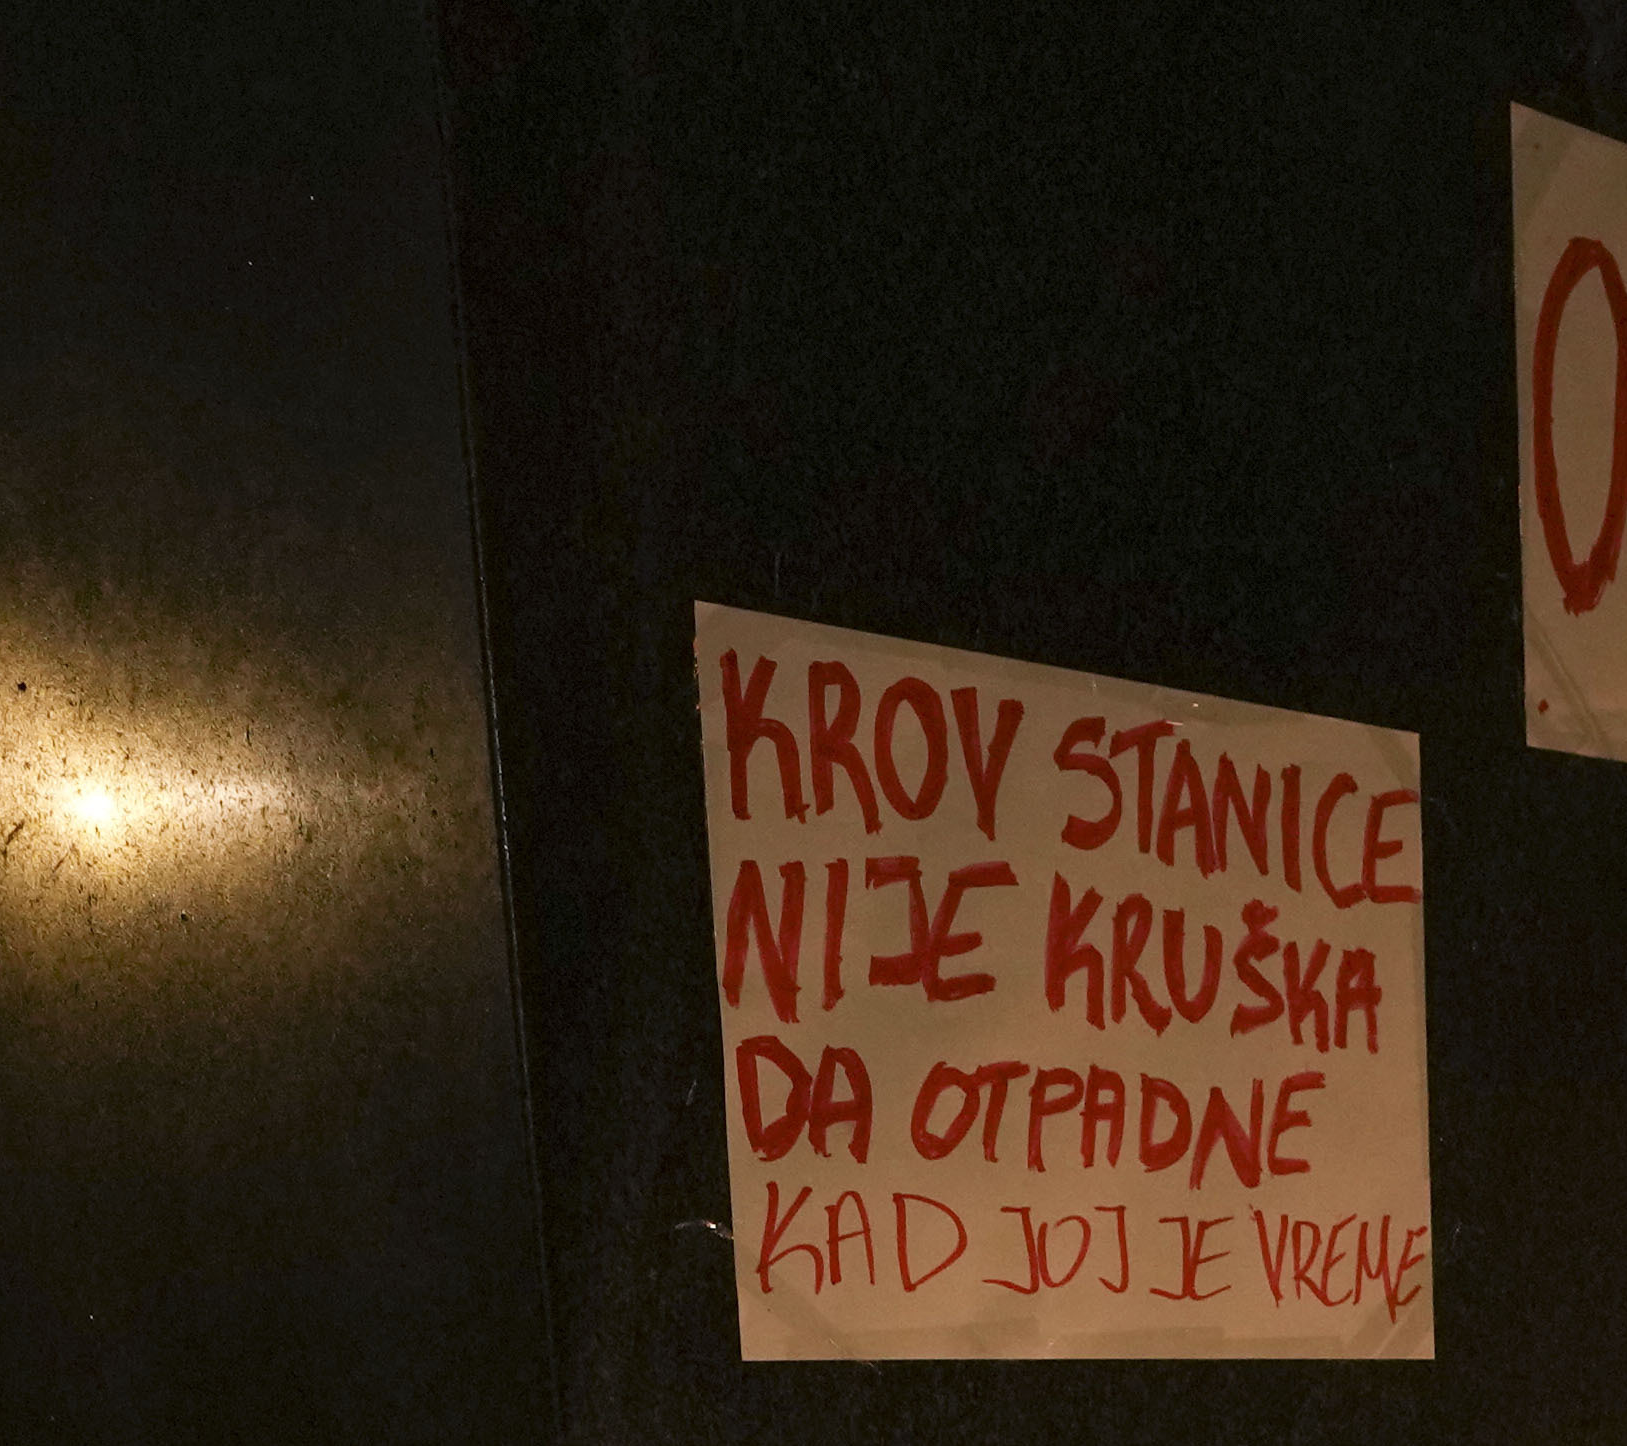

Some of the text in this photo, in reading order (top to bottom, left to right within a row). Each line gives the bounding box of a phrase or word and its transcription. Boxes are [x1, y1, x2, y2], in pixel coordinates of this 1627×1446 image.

[720, 649, 1421, 909] KROV STANICE
[722, 857, 1382, 1053] NIJE KRUŠKA
[735, 1036, 1326, 1190] DA OTPADNE
[756, 1181, 1428, 1323] KAD JOJ JE VREME
